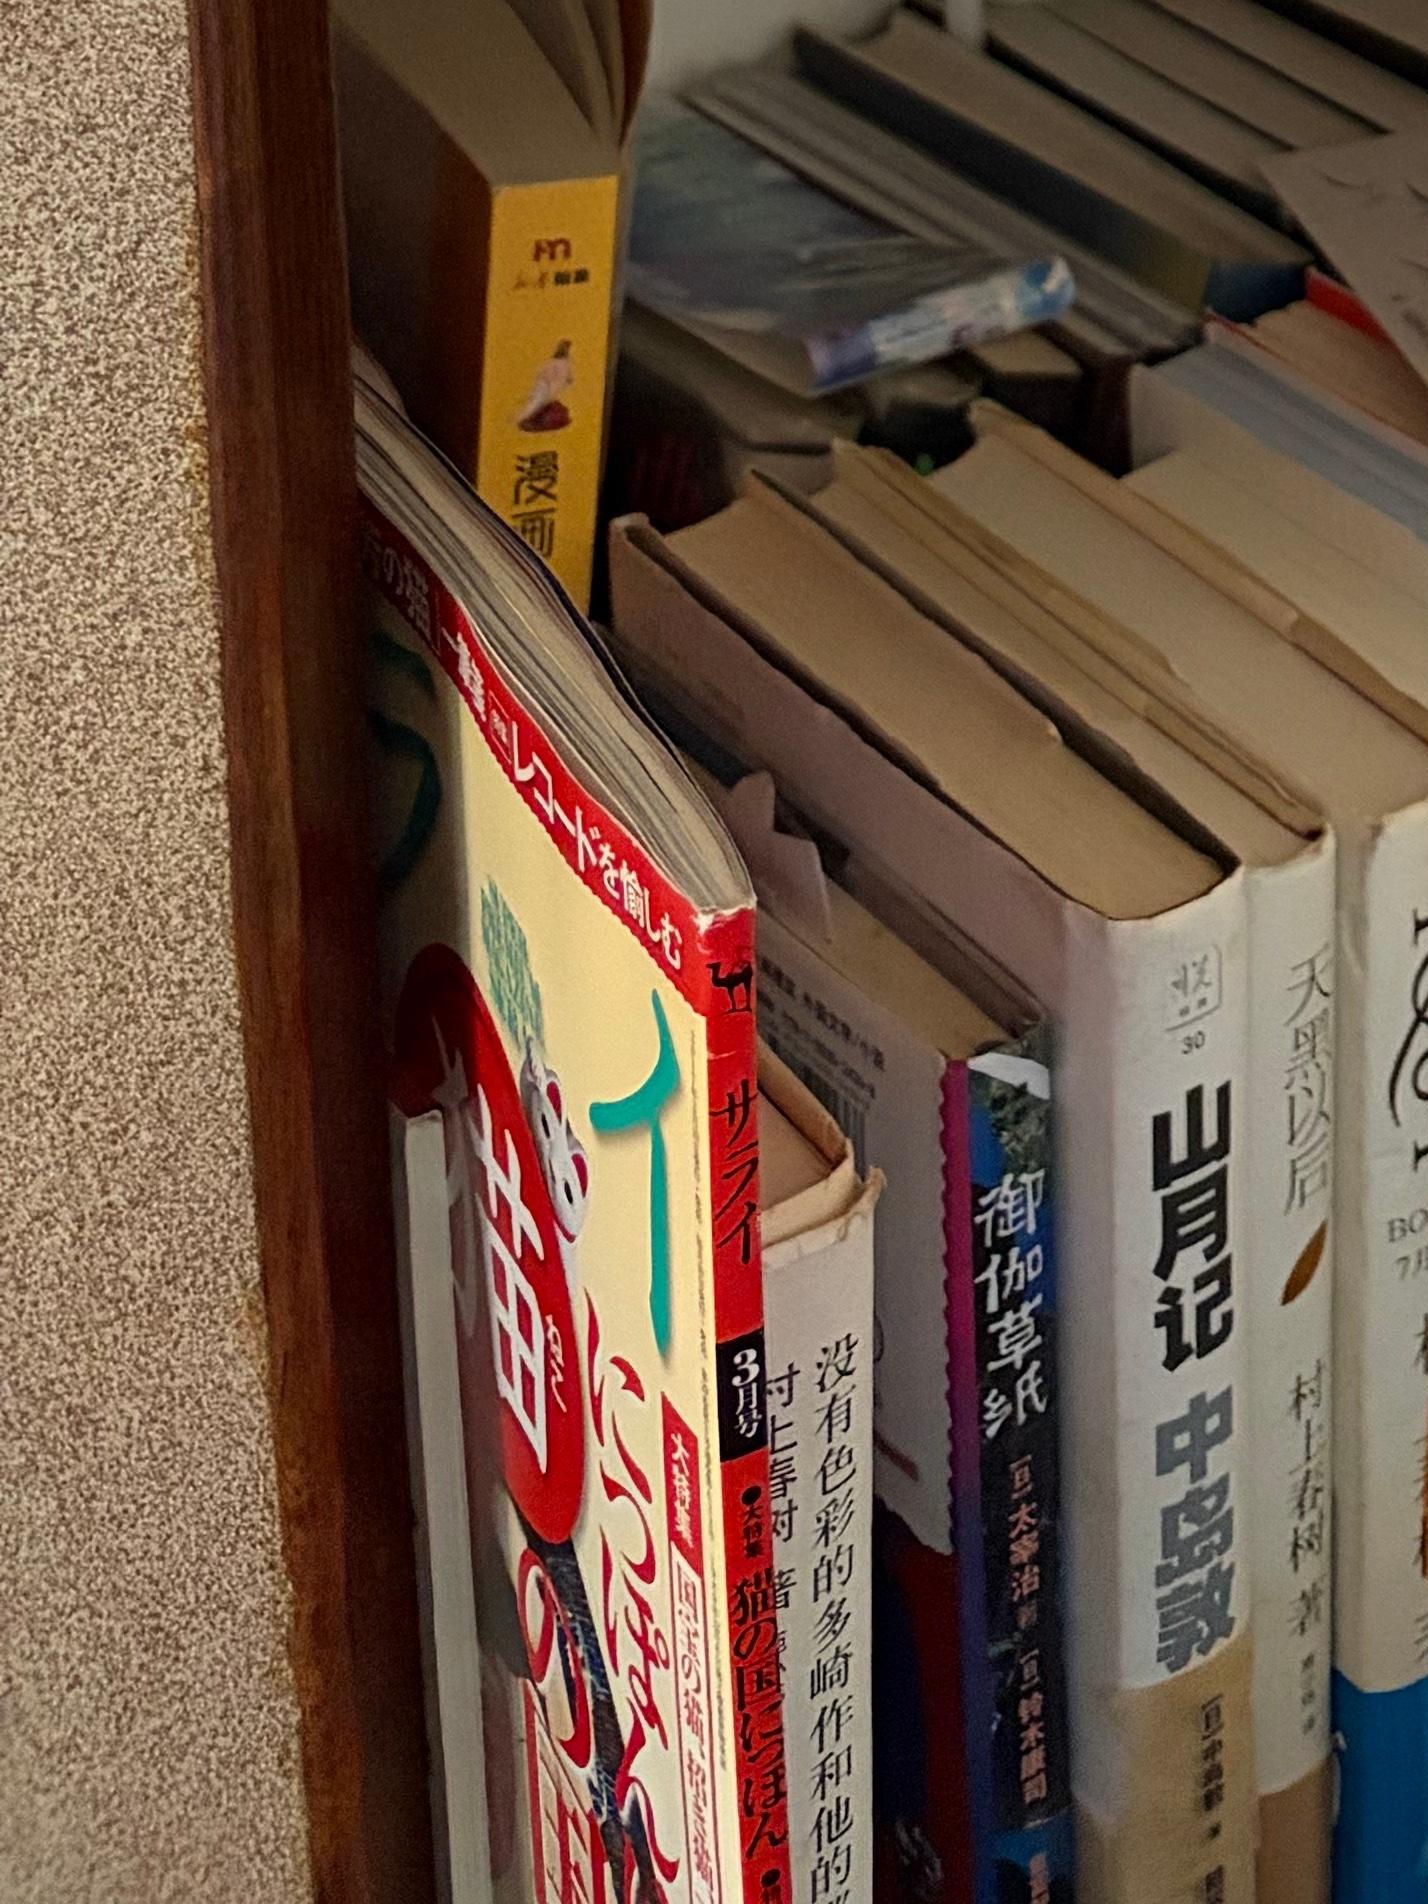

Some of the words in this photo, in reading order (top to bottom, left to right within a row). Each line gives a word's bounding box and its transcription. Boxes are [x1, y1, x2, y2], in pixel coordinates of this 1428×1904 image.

[1284, 941, 1332, 1216] 天黑以后
[972, 1169, 1049, 1440] 御伽草纸
[1153, 1082, 1234, 1373] 山月记
[731, 1349, 764, 1439] 3月号
[1154, 1385, 1236, 1673] 中岛敦
[806, 1330, 860, 1904] 没有色彩的多崎作和他的
